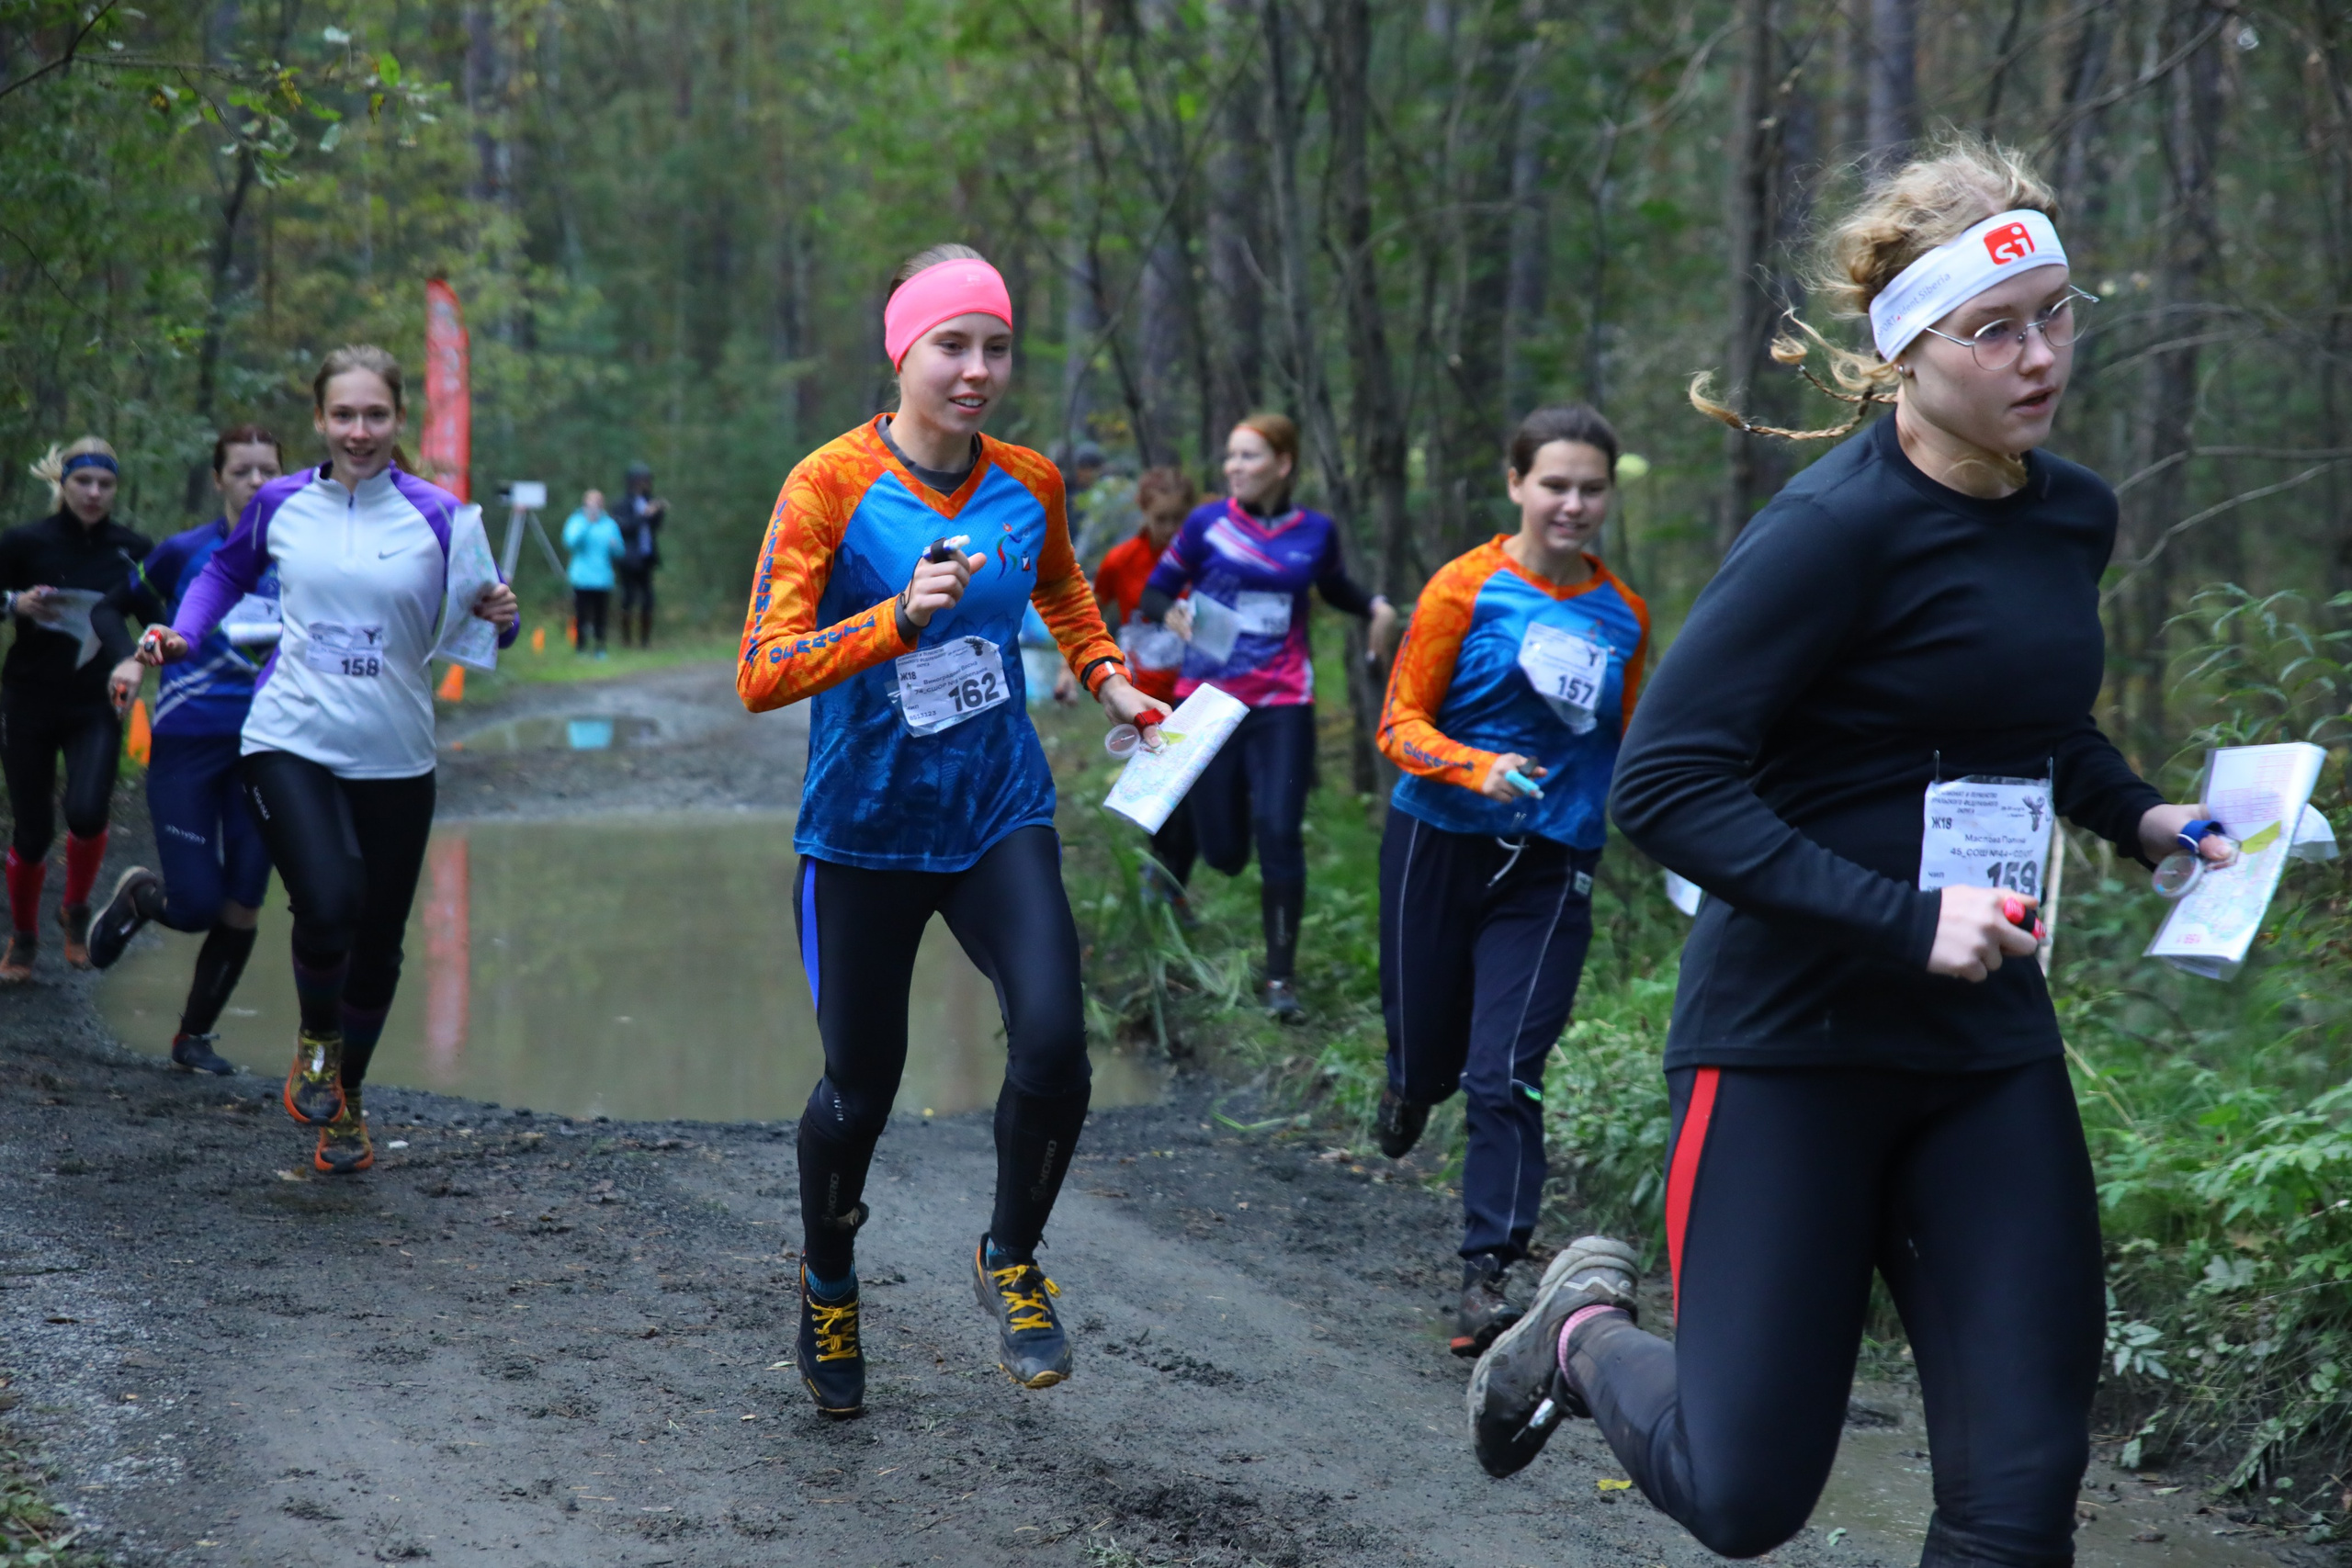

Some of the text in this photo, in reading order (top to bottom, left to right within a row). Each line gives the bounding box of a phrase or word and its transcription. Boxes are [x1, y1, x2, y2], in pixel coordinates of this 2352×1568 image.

[1918, 273, 1951, 300] Siberia
[341, 658, 379, 676] 158
[899, 671, 917, 682] Ж18
[948, 672, 1000, 712] 162
[1558, 673, 1595, 705] 157
[1931, 817, 1952, 829] Ж18
[1986, 861, 2037, 897] 159
